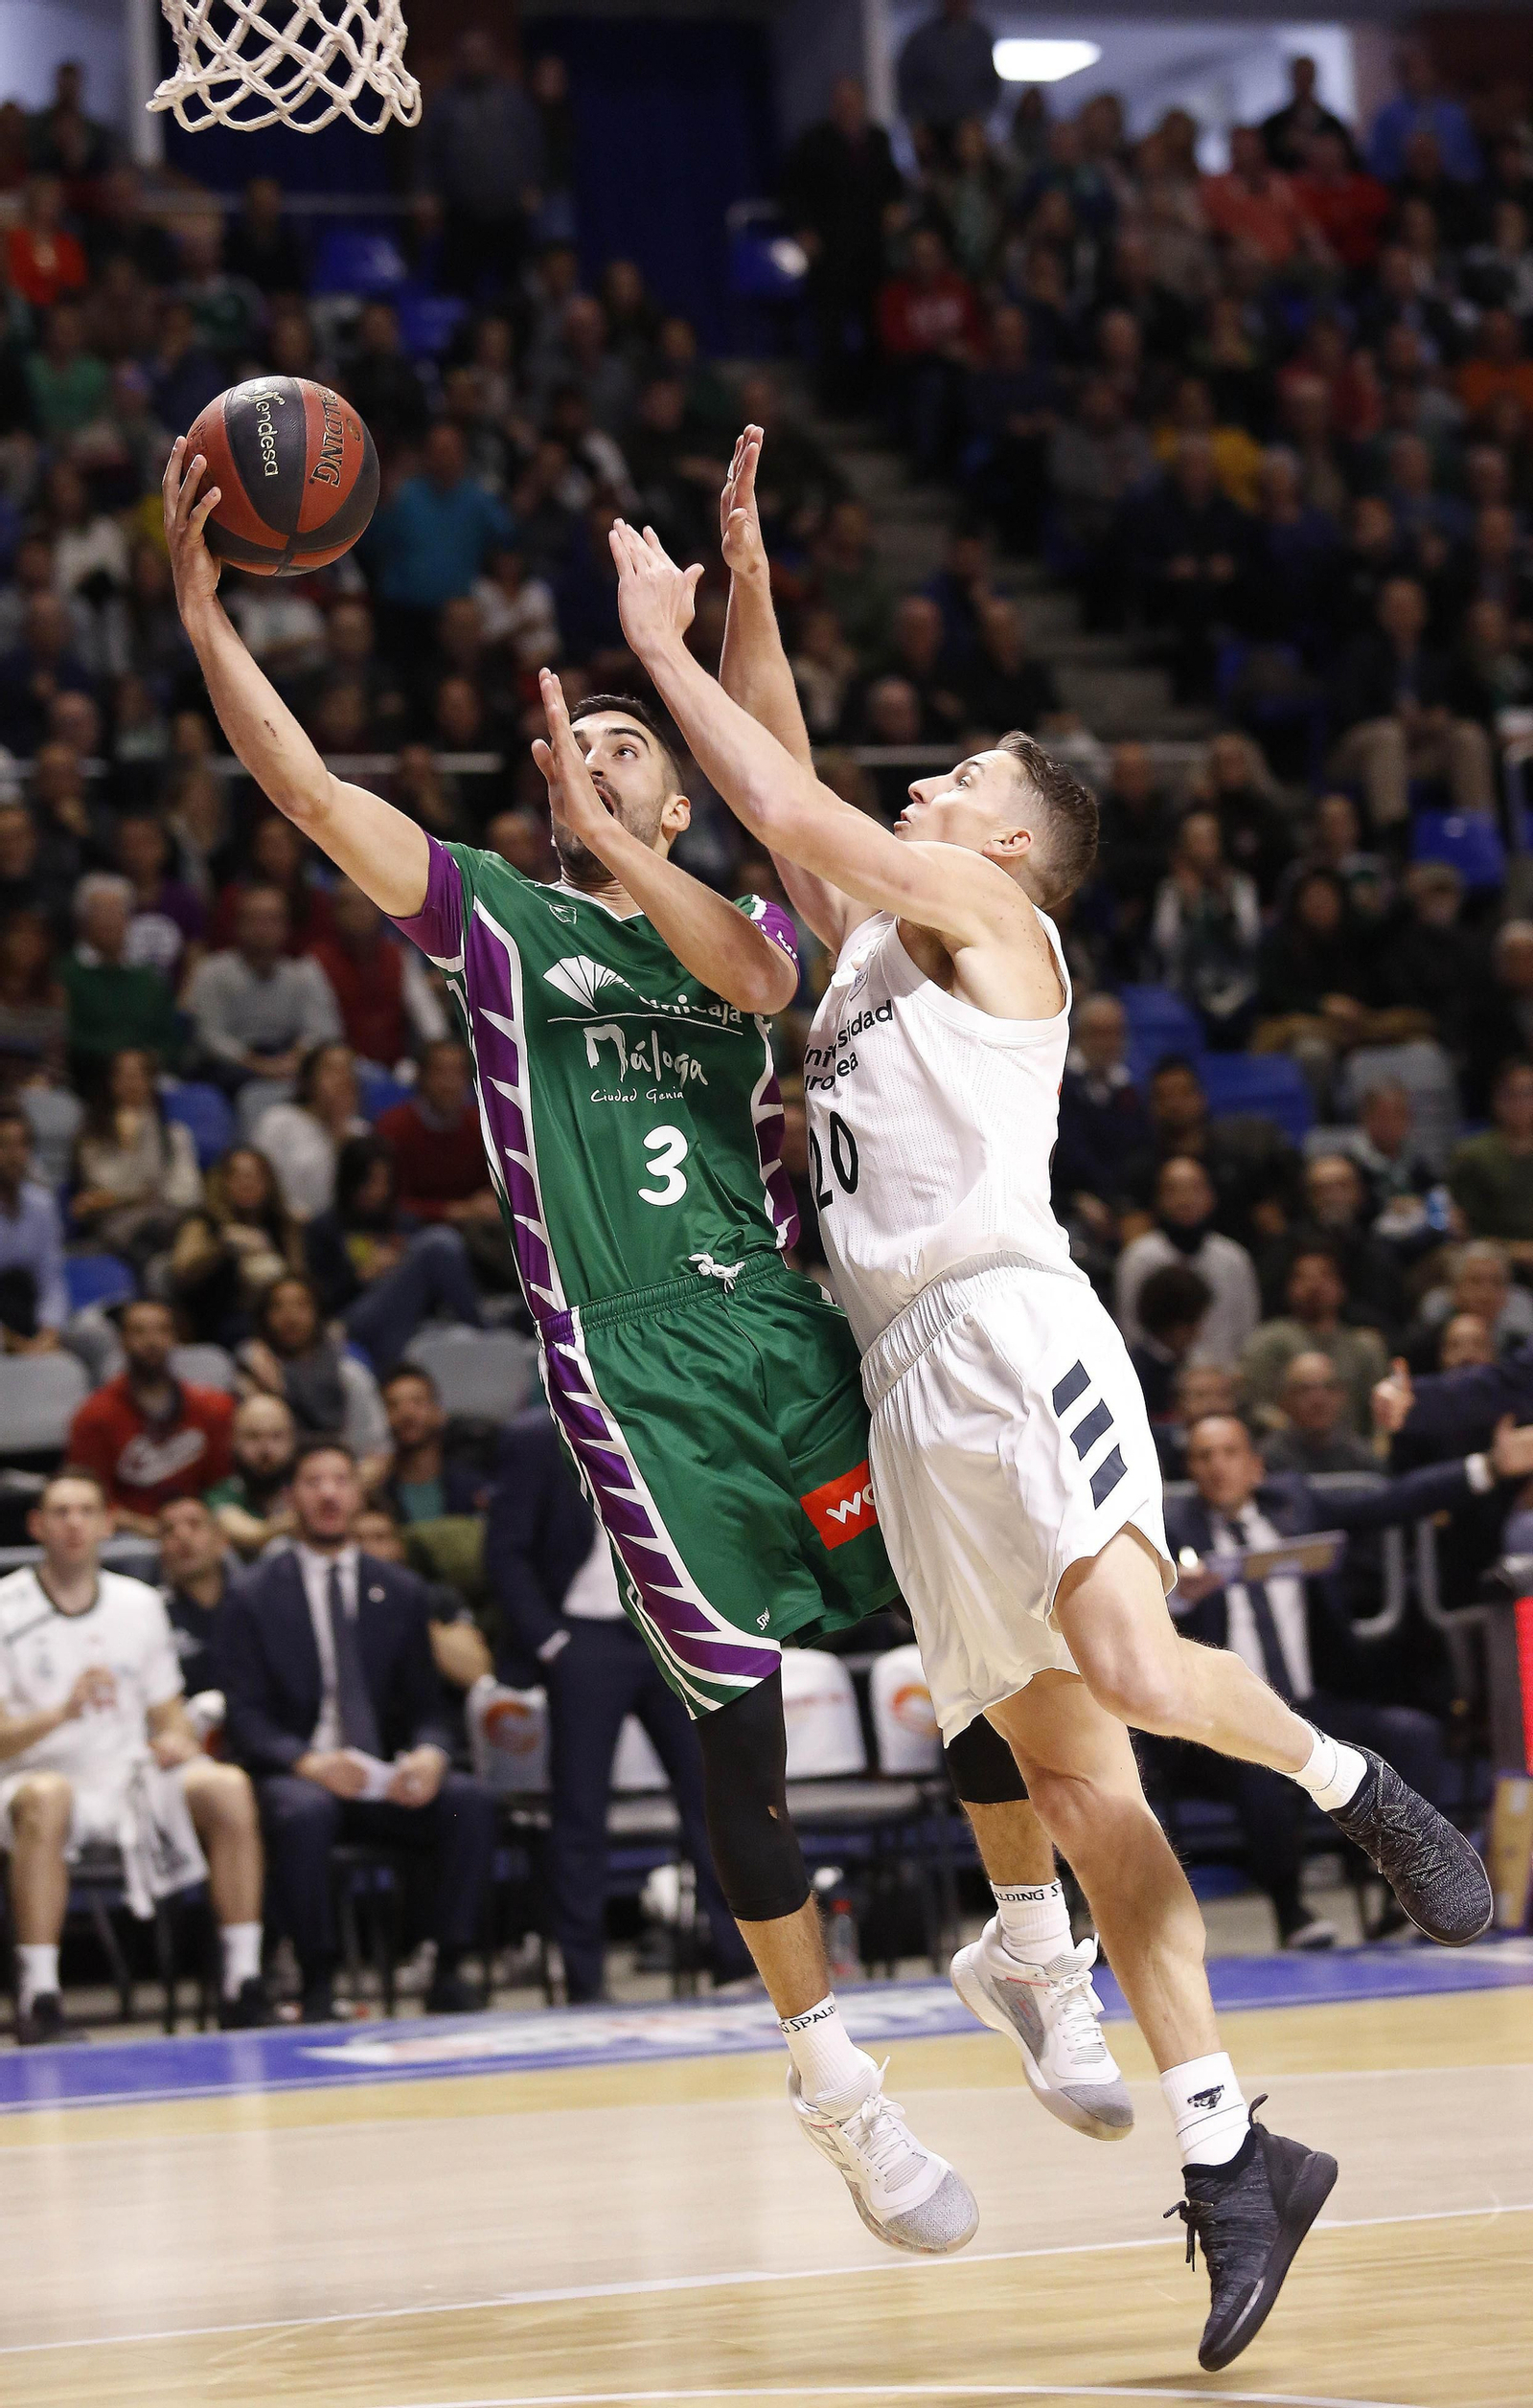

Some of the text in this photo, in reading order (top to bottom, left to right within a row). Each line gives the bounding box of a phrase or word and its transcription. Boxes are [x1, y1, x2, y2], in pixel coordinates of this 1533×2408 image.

[255, 400, 279, 477] endesa
[590, 1085, 685, 1104] Ciudad Genia
[637, 1124, 689, 1207] 3
[809, 1110, 859, 1212] 20
[789, 2003, 836, 2033] SPALD
